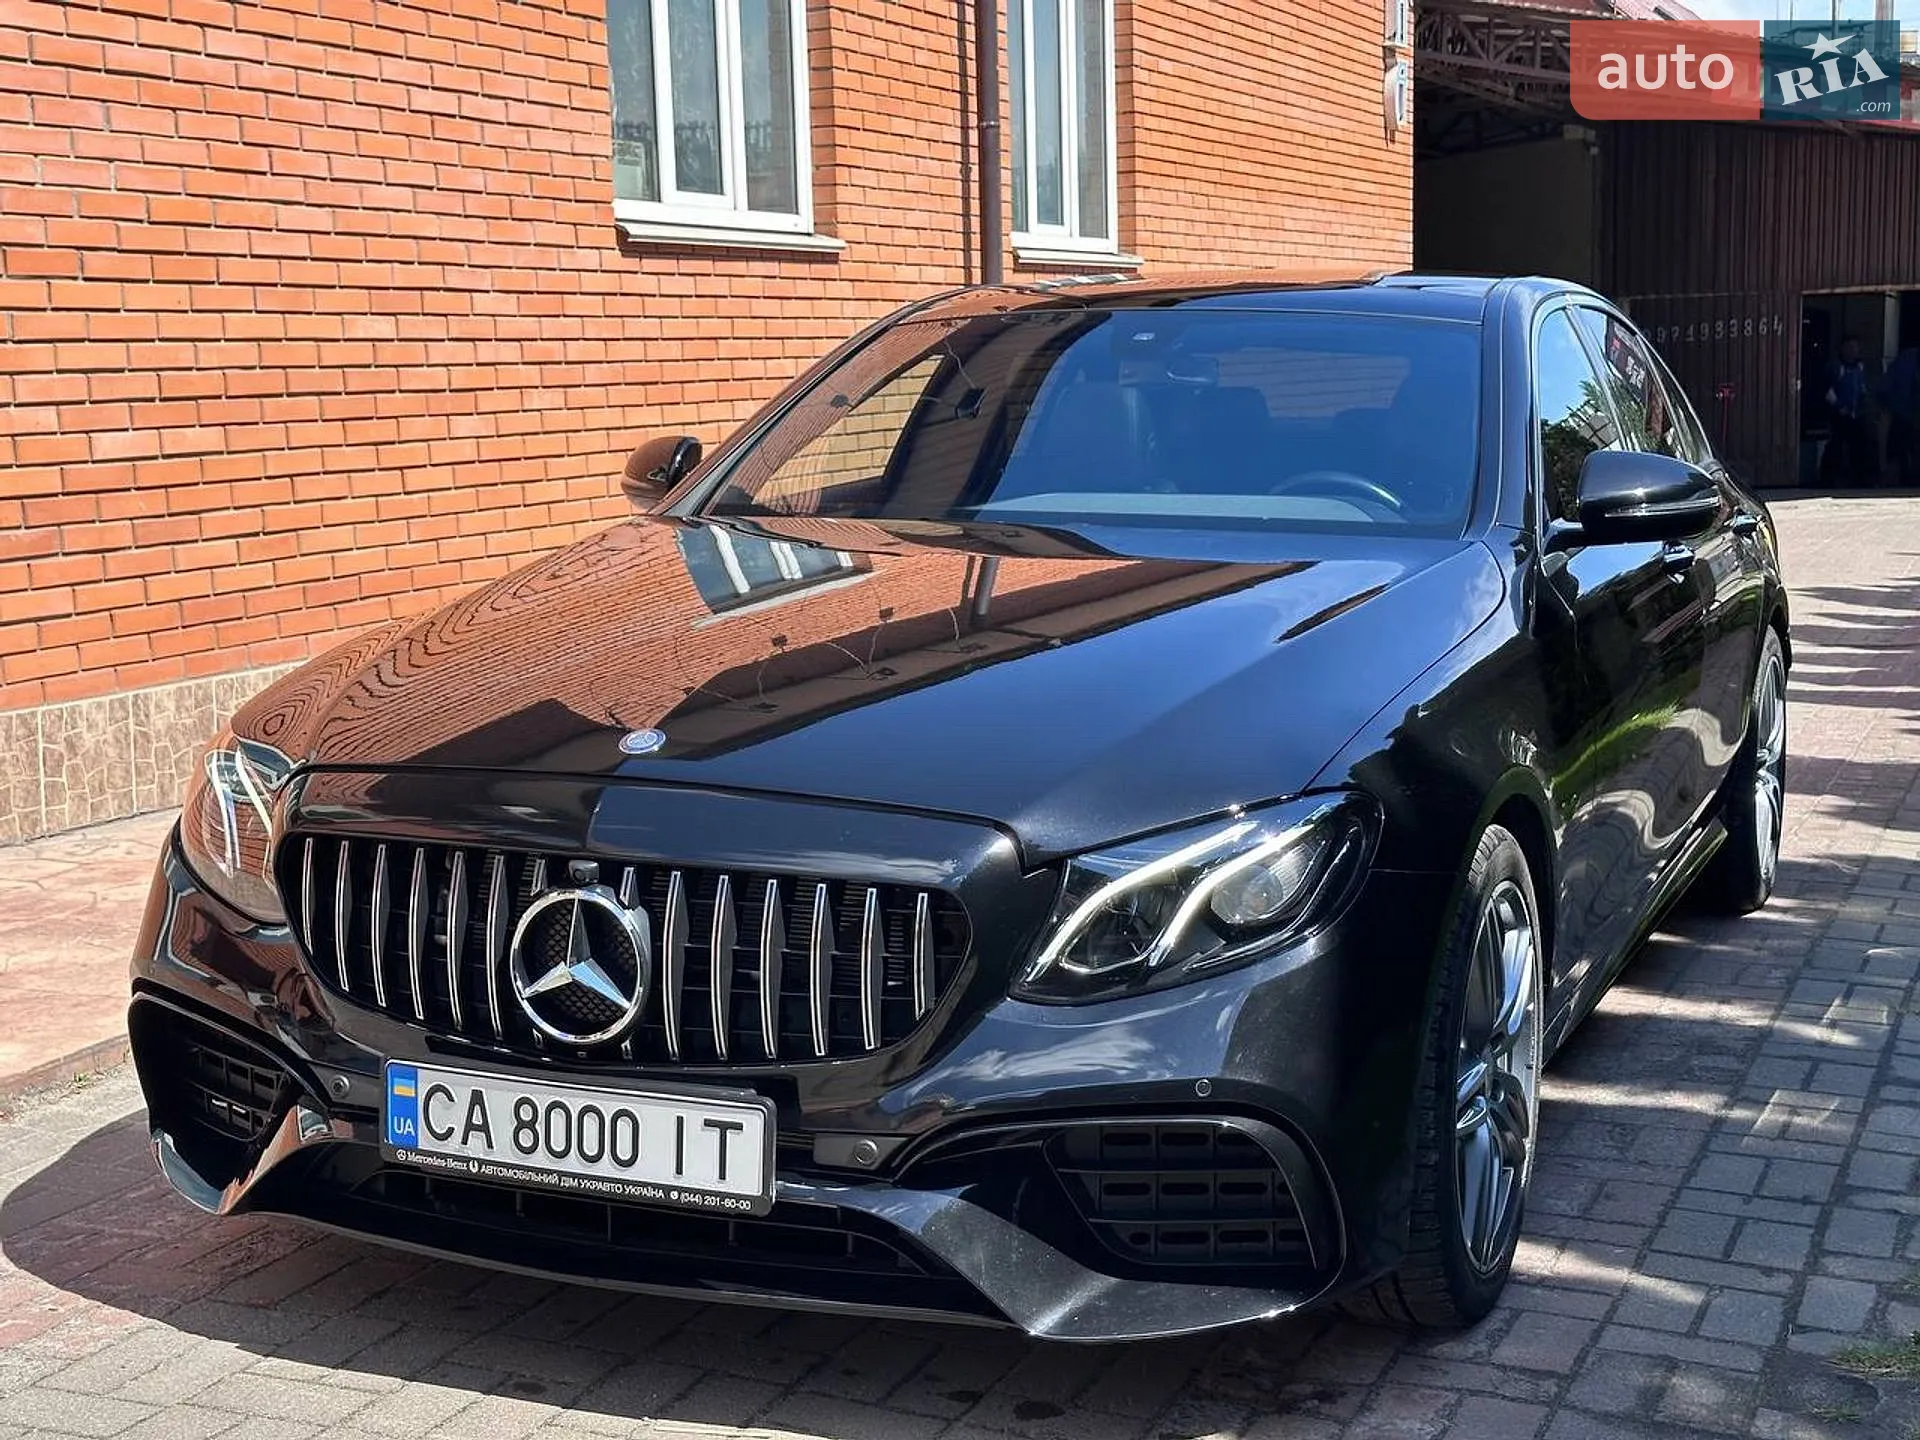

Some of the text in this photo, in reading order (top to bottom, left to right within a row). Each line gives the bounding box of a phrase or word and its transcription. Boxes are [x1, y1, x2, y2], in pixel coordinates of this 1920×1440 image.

[393, 1118, 416, 1137] UA
[422, 1082, 744, 1181] CA 8000 IT
[406, 1150, 468, 1170] Mercedes-Benz
[480, 1164, 665, 1200] АВТОМОБІЛЬНИЙ ДІМ УКРАВТО УКРАЇНА
[680, 1192, 752, 1211] (044) 201-60-00
